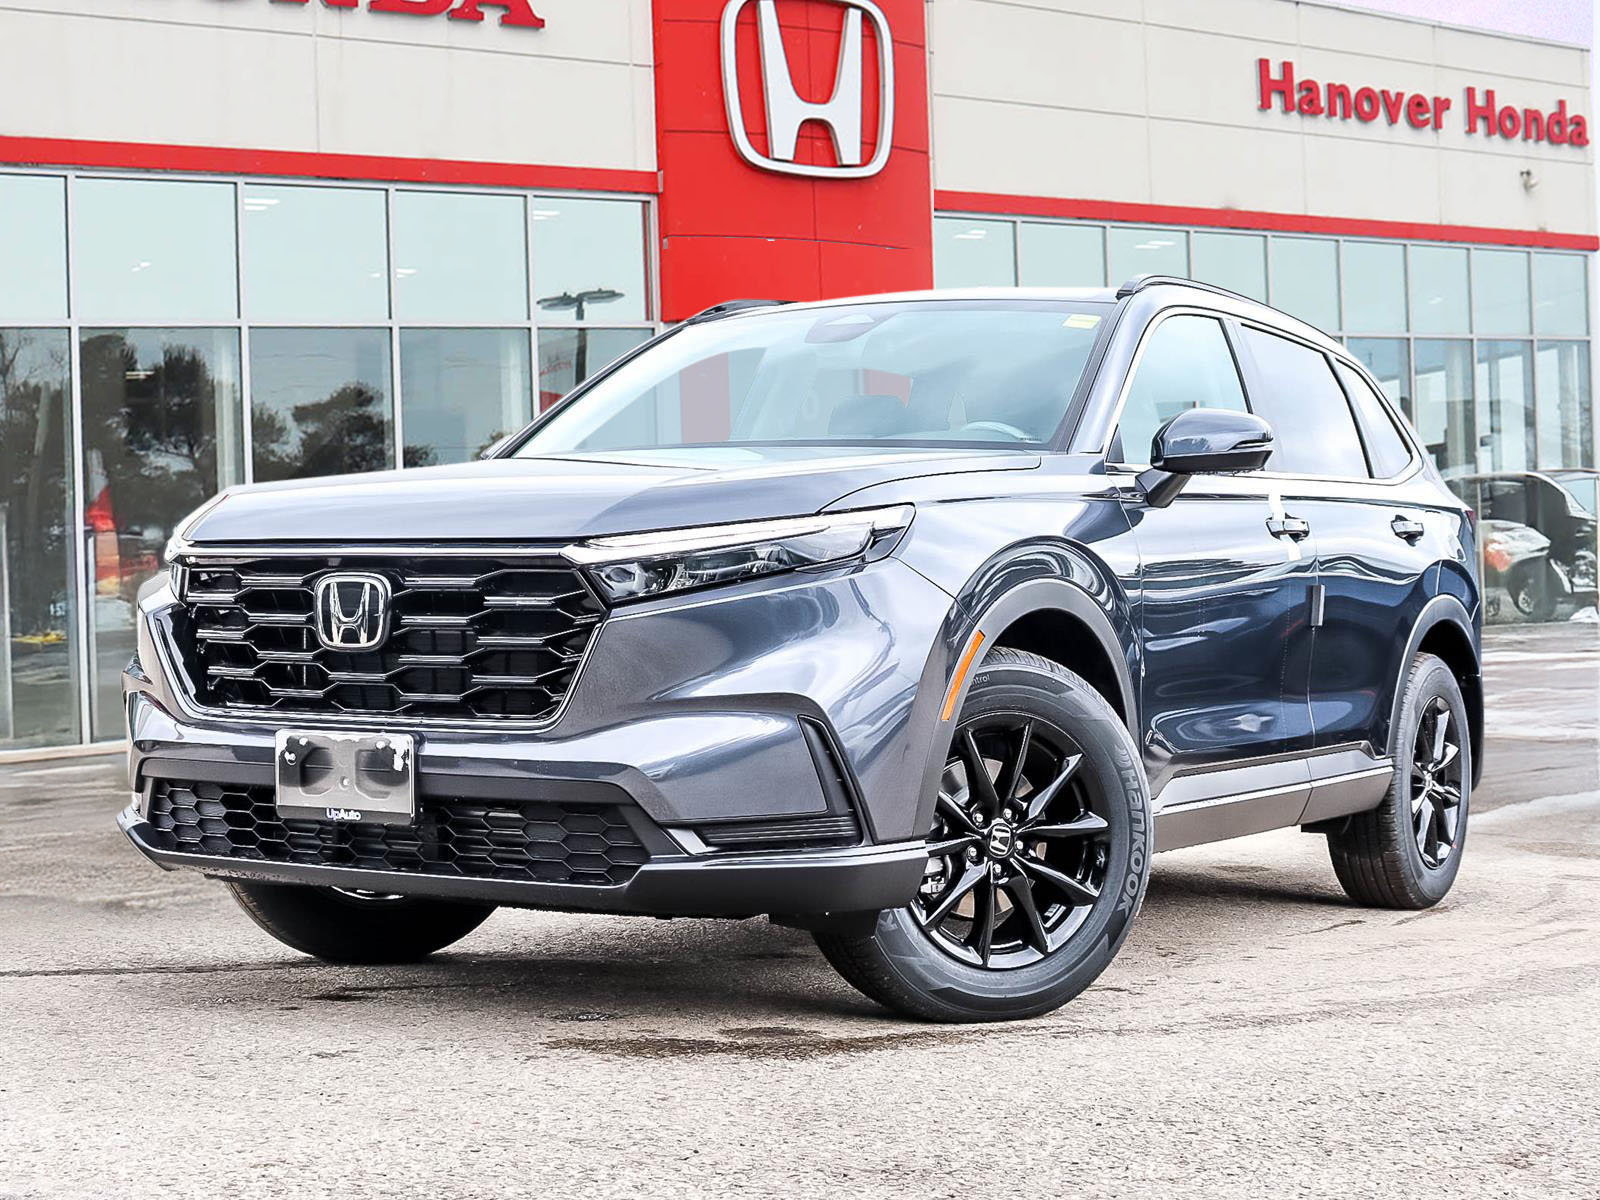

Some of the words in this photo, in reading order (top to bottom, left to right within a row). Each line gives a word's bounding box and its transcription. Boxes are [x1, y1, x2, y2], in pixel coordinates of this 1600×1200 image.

[1257, 58, 1452, 131] Hanover
[1465, 86, 1590, 147] Honda
[326, 807, 361, 821] UpAuto
